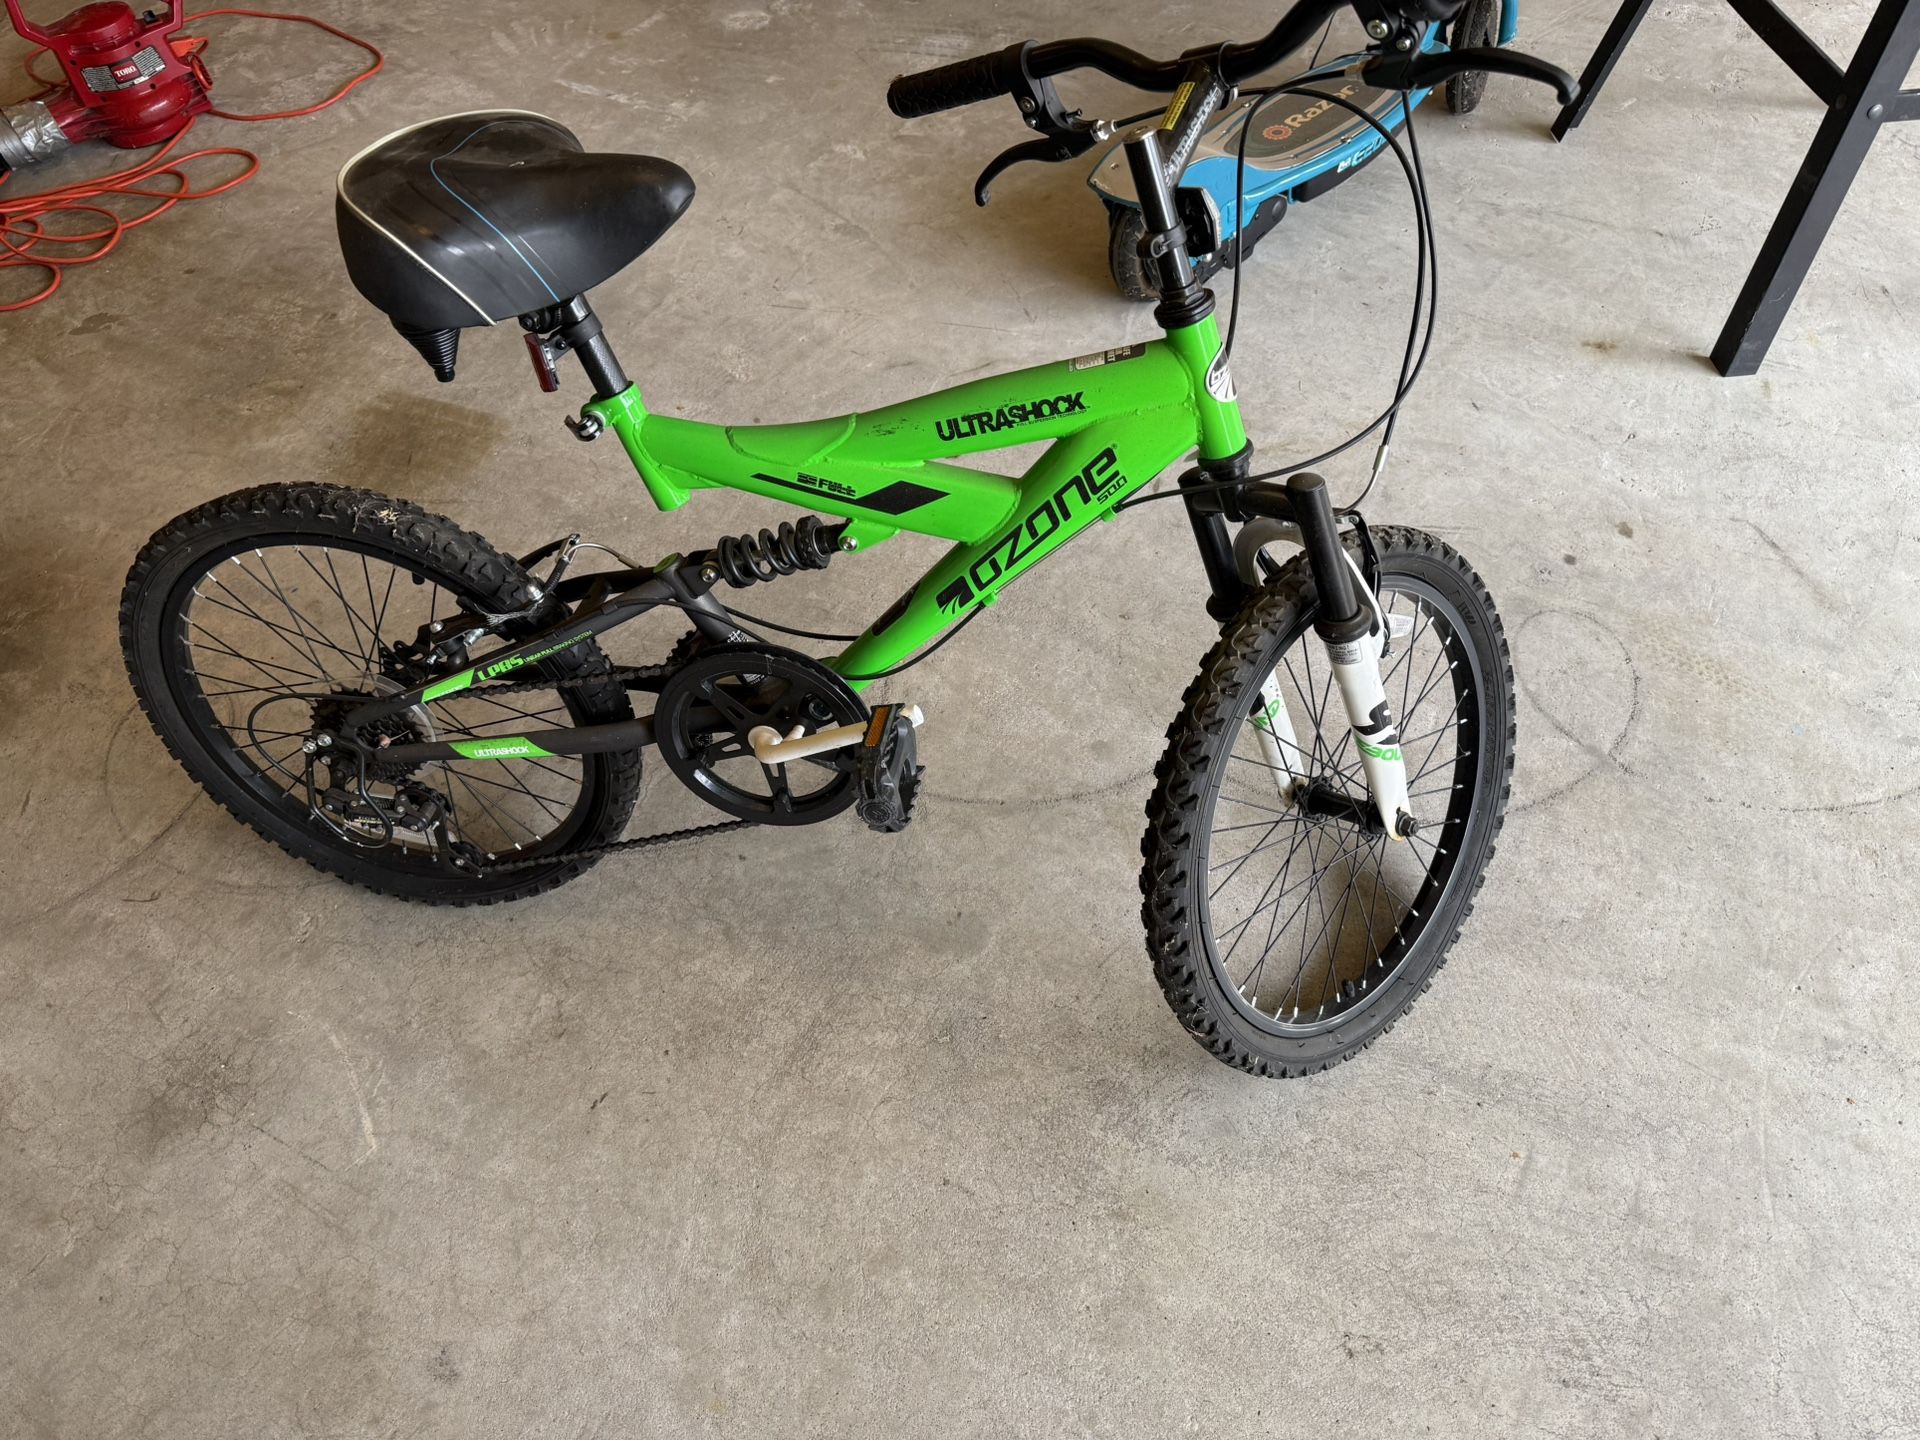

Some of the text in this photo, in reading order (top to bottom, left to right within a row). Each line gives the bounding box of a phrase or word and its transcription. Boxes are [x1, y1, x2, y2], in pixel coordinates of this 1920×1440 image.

[114, 65, 137, 77] TORO
[935, 392, 1086, 441] ULTRASHOCK
[477, 653, 525, 681] LPBS
[474, 746, 530, 758] ULTRASHOCK
